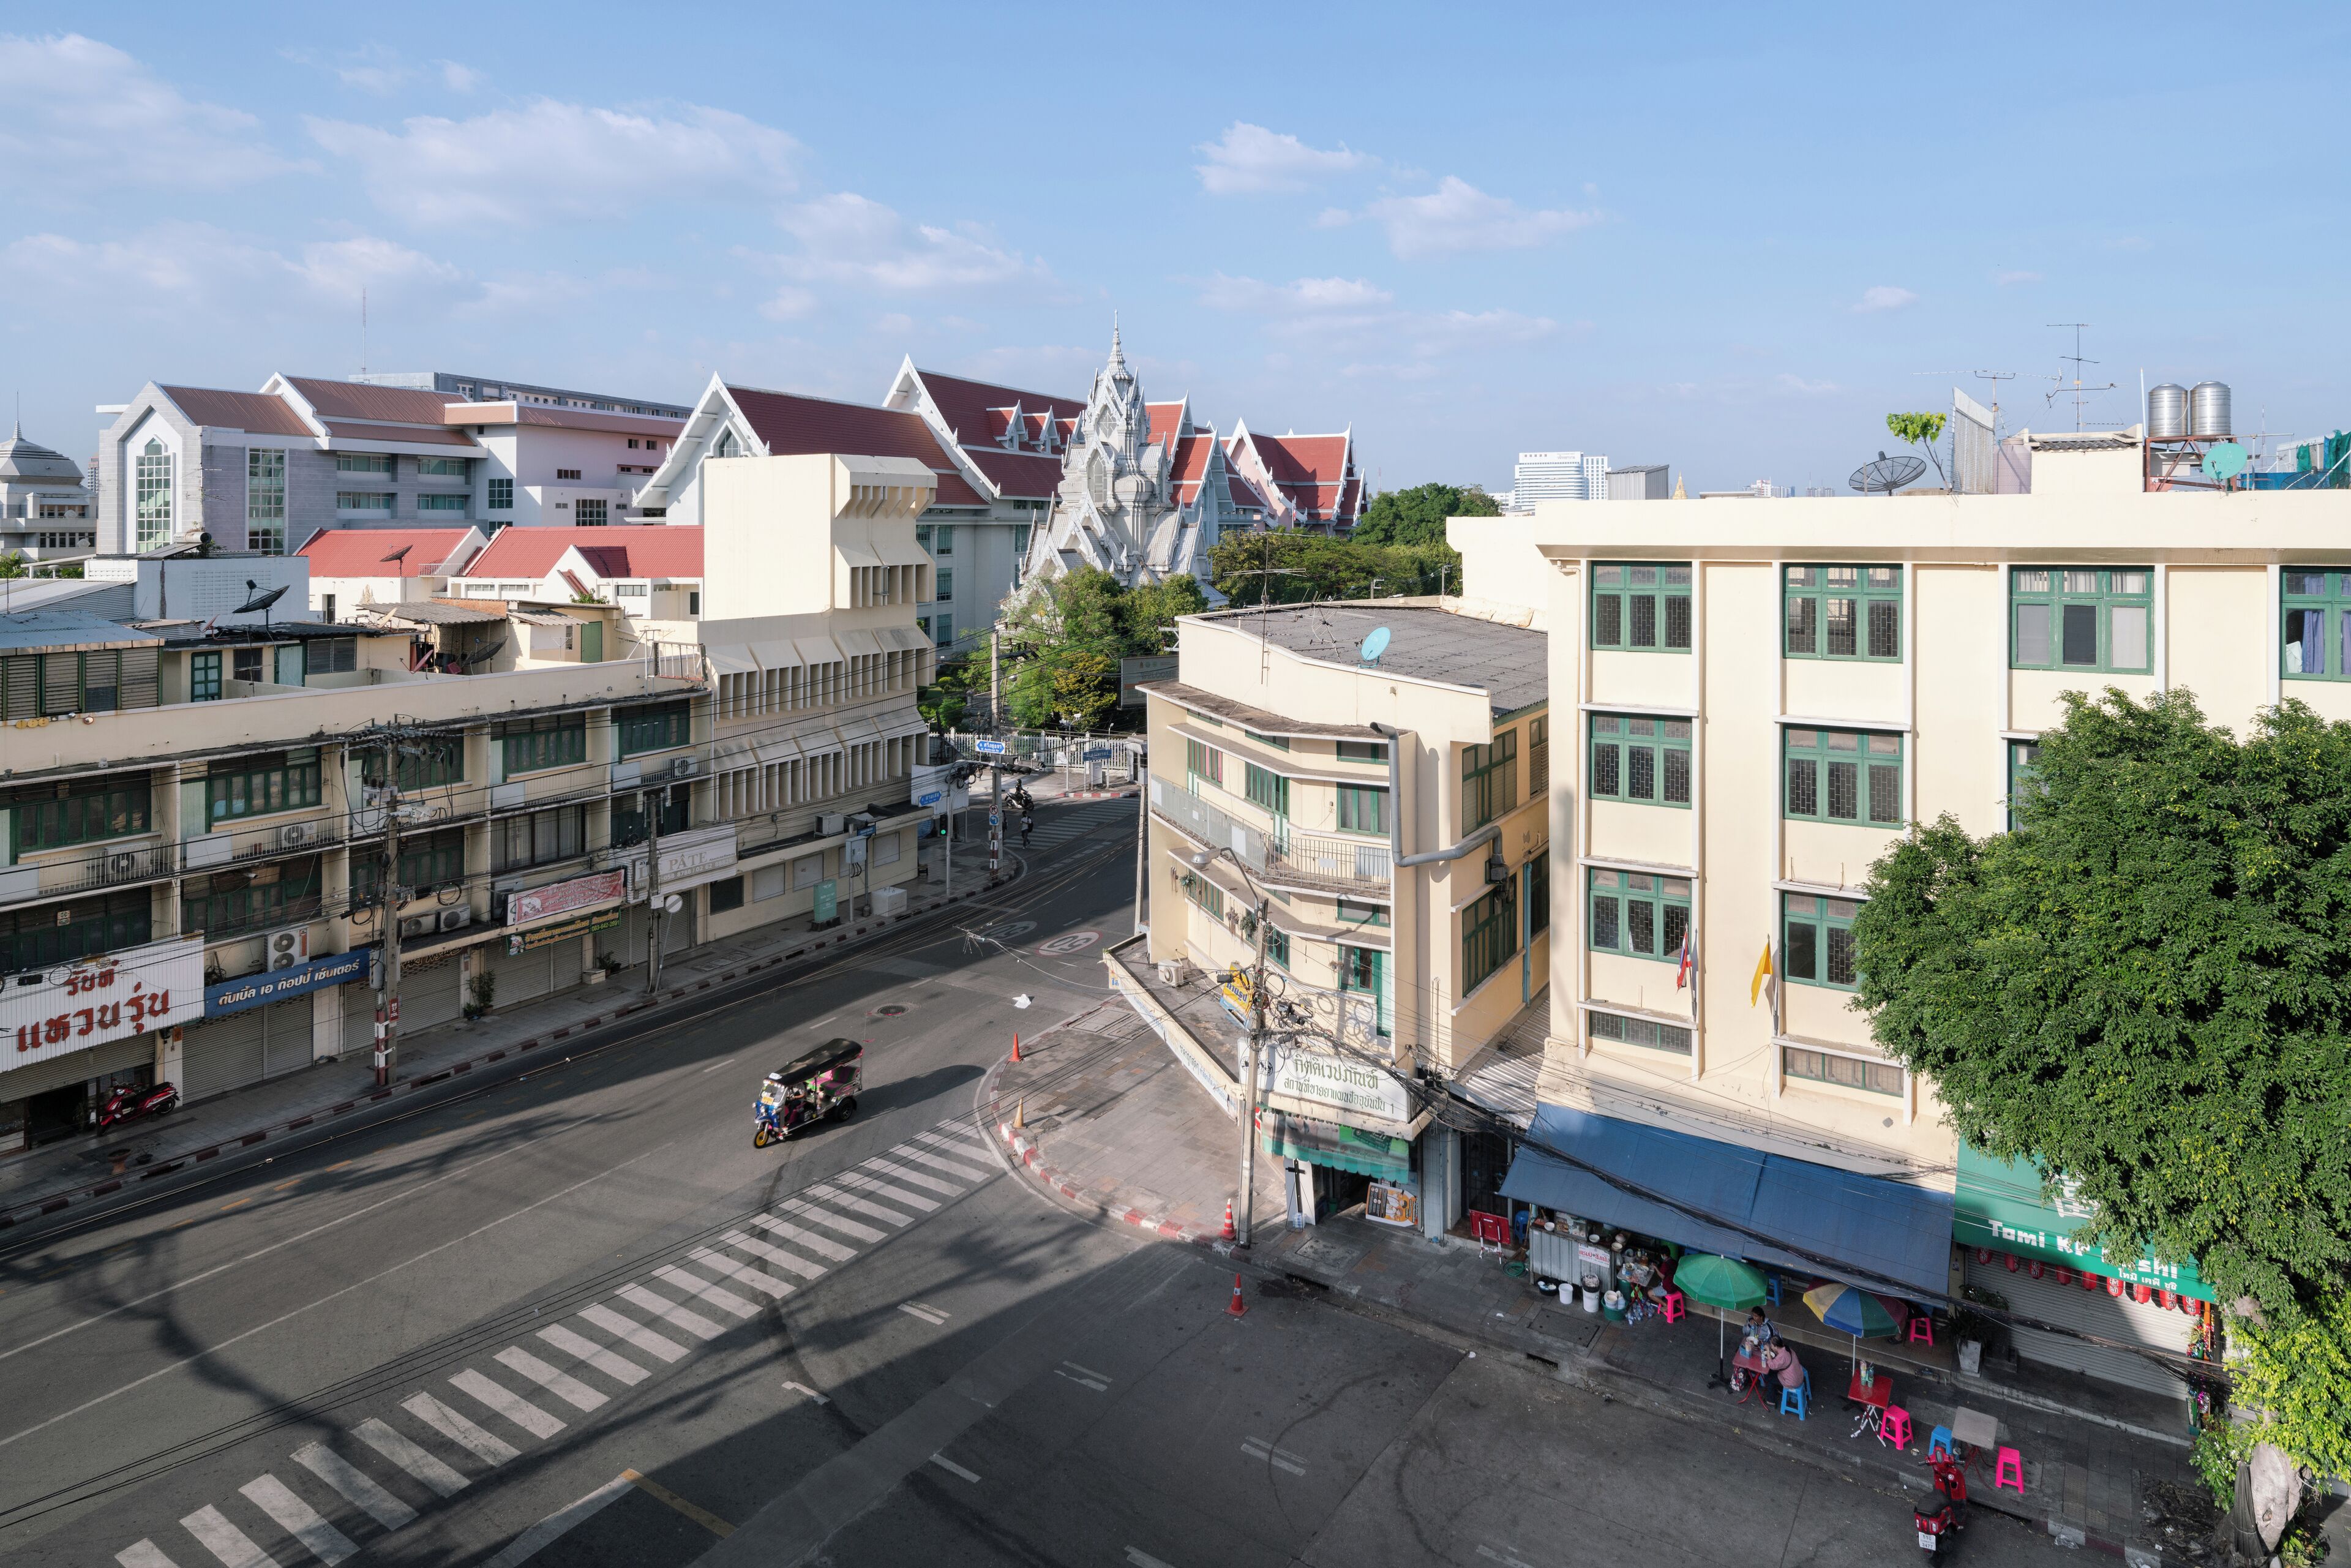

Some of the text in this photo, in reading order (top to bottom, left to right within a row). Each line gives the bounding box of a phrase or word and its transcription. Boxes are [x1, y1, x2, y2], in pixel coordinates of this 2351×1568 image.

[669, 852, 707, 871] PÂTE
[260, 983, 274, 996] เอ
[17, 981, 171, 1052] แหวนรุ่น
[1989, 1218, 2045, 1248] Tomi
